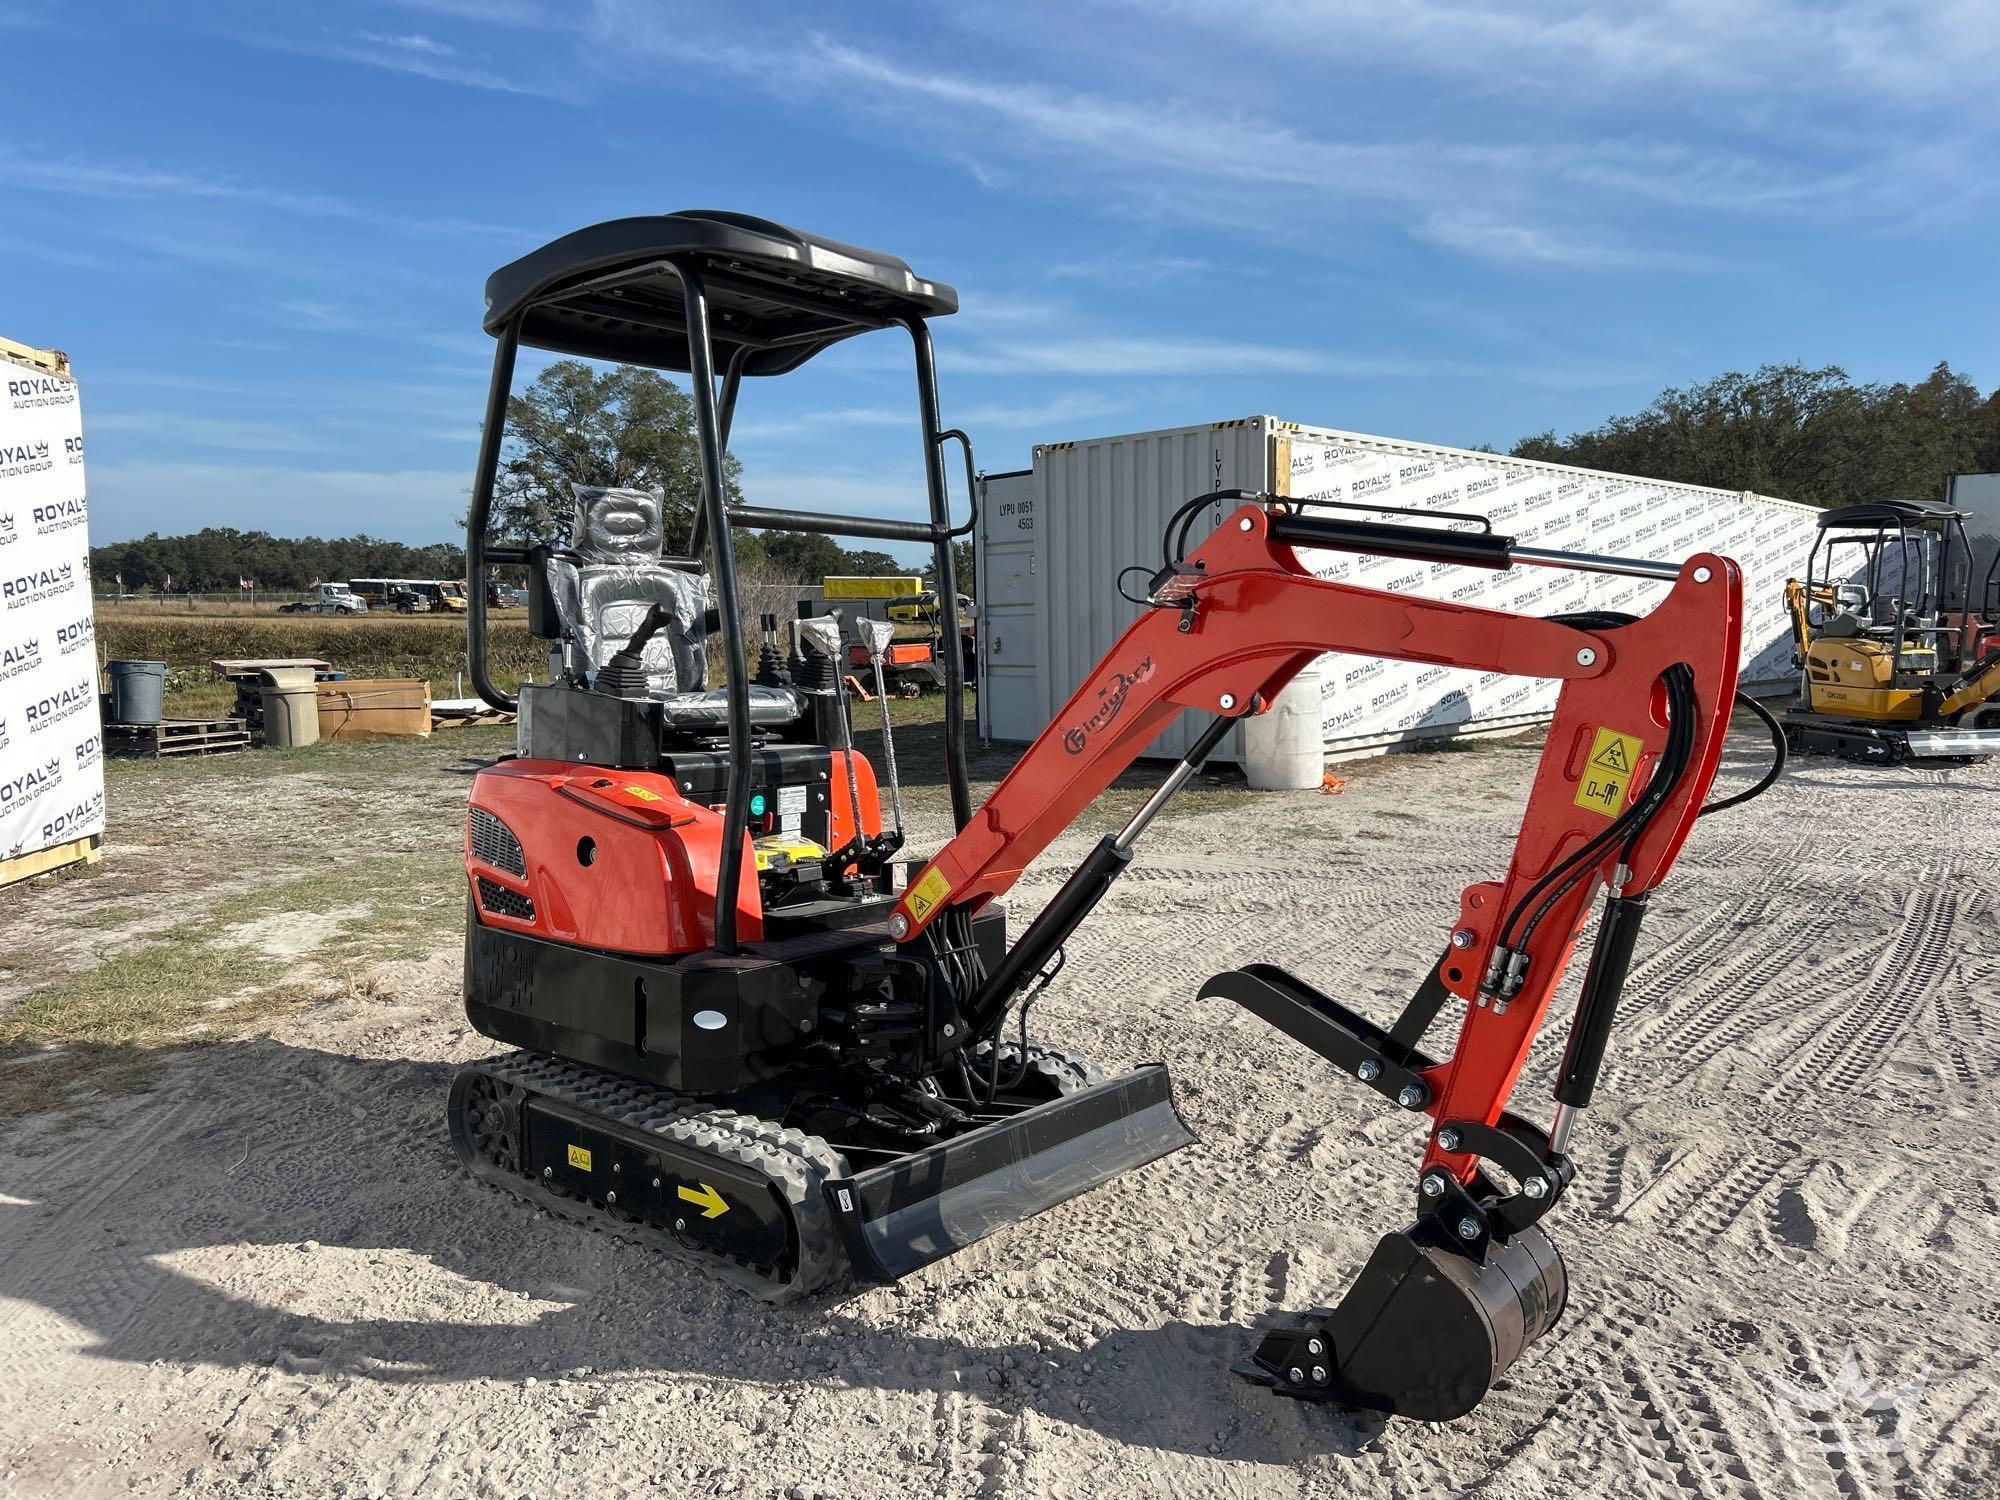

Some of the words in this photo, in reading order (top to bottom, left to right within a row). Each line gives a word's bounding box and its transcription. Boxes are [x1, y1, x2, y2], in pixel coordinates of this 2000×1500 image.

[8, 378, 60, 397] ROYAL
[13, 398, 49, 409] AUCTION
[50, 395, 74, 405] GROUP
[0, 445, 36, 465] YAL
[23, 461, 53, 474] GROUP
[1399, 463, 1428, 478] ROYAL
[1351, 476, 1383, 492] ROYAL
[1467, 478, 1492, 493] ROYAL
[1426, 490, 1452, 506] ROYAL
[1524, 493, 1547, 506] ROYAL
[33, 498, 82, 524] ROYAL
[999, 503, 1015, 517] LYPU
[1487, 504, 1512, 519] ROYAL
[37, 520, 73, 535] AUCTION
[1544, 517, 1565, 530] ROYAL
[0, 533, 18, 545] OUP
[1514, 528, 1533, 541] OYAL
[1315, 565, 1340, 579] OYAL
[3, 569, 60, 598] ROYAL
[1386, 574, 1416, 590] ROYAL
[1452, 582, 1478, 599] ROYAL
[1548, 576, 1569, 590] ROYAL
[7, 590, 46, 610] AUCTION
[47, 581, 75, 597] GROUP
[1514, 591, 1536, 606] ROYAL
[10, 657, 42, 676] GROUP
[1345, 663, 1376, 683] ROYAL
[1416, 667, 1443, 685] ROYAL
[26, 687, 80, 722] ROYAL
[1372, 687, 1401, 707] ROYAL
[1440, 689, 1467, 706] ROYAL
[1500, 690, 1523, 706] ROYAL
[29, 709, 67, 734] AUCTION
[1322, 710, 1354, 730] ROYAL
[1398, 709, 1427, 728] ROYAL
[75, 733, 100, 760] ROY
[0, 768, 47, 802] OYAL
[0, 793, 33, 819] UCTION
[34, 776, 62, 798] GROUP
[42, 800, 93, 840] ROYAL
[80, 806, 104, 828] GROUP
